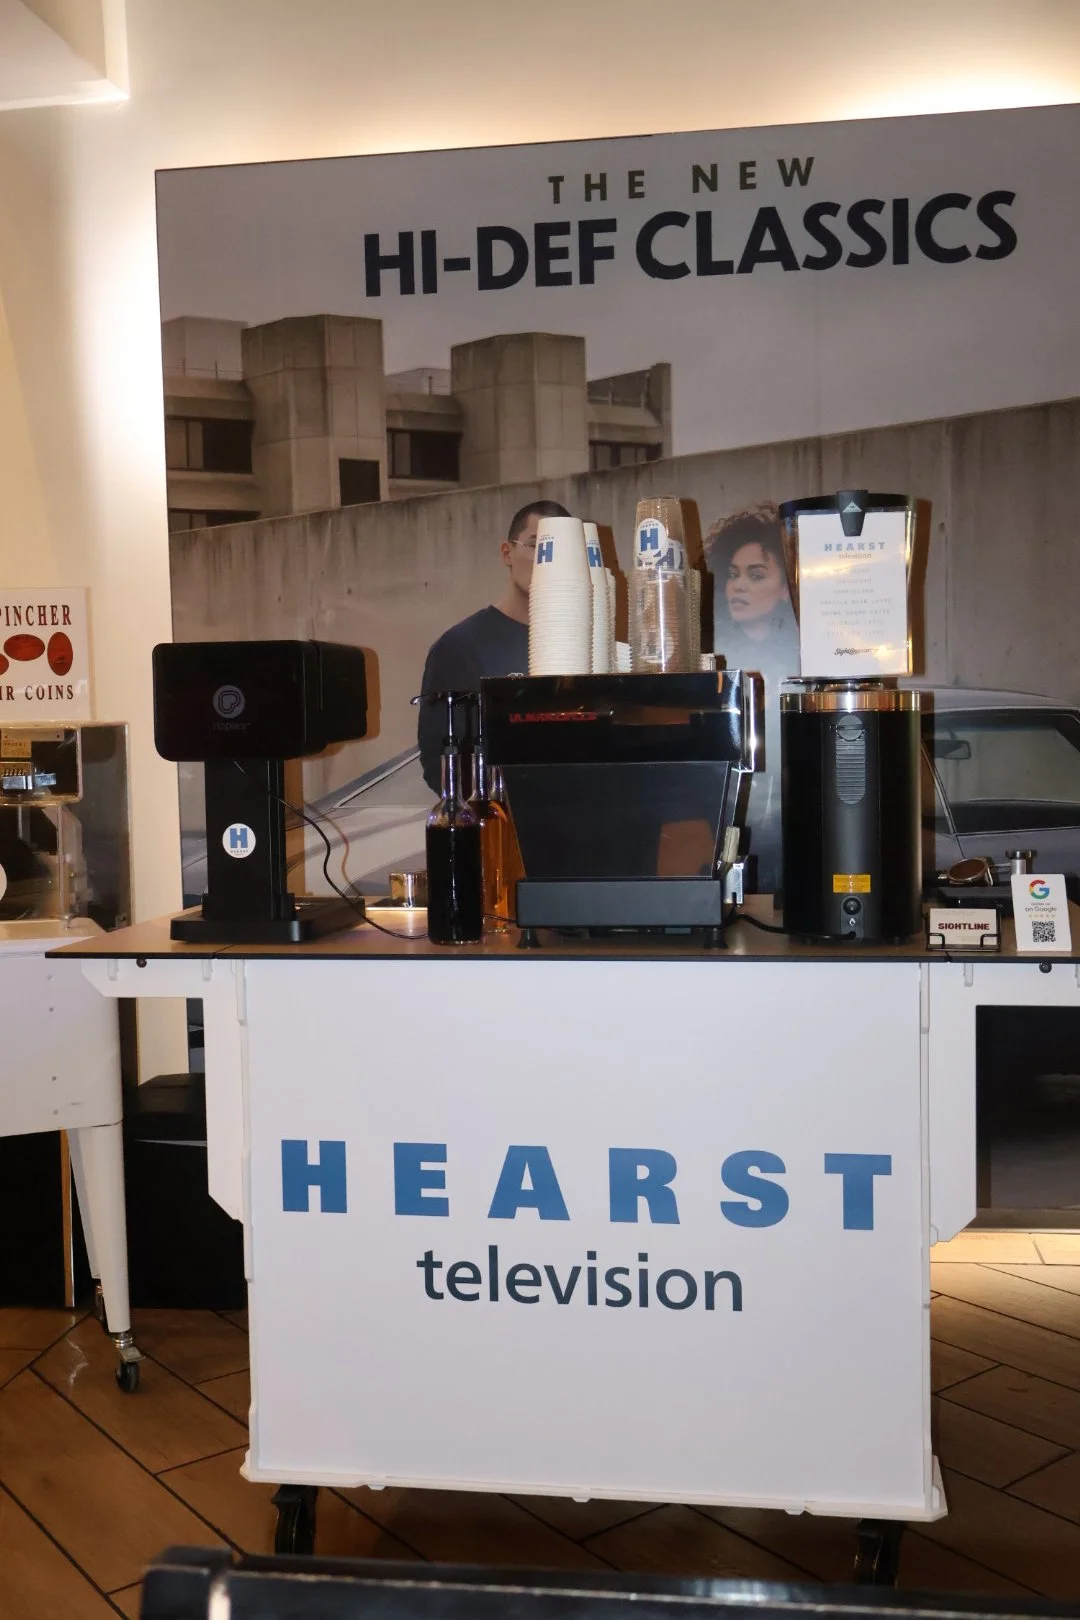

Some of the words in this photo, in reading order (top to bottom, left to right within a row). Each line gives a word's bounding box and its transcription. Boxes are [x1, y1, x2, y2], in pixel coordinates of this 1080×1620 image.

[548, 170, 646, 204] THE
[692, 157, 814, 194] NEW
[364, 218, 618, 297] HI-DEF
[636, 190, 1018, 280] CLASSICS
[824, 541, 886, 552] HEARST
[0, 604, 72, 626] INCHER
[25, 685, 74, 701] COINS
[230, 828, 248, 849] H
[938, 922, 990, 931] SIGHTLINE
[281, 1139, 892, 1231] HEARST
[416, 1245, 743, 1311] television
